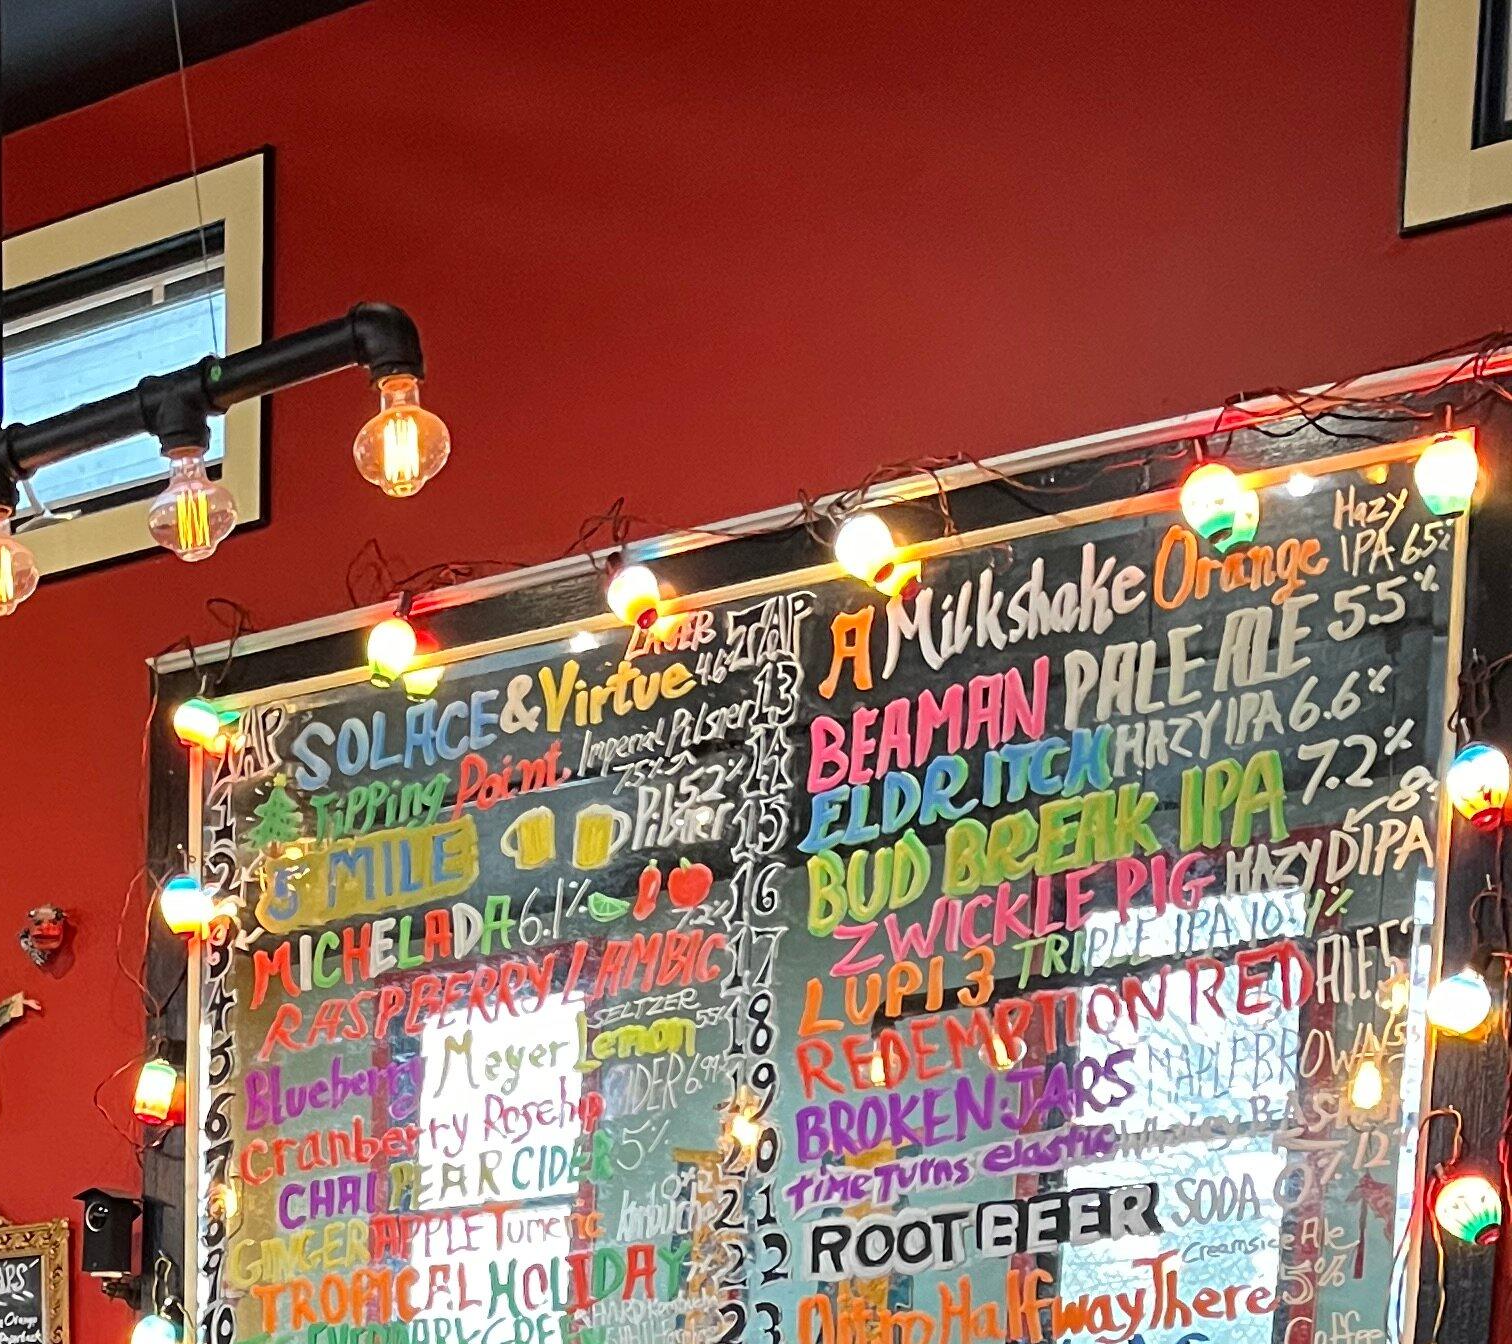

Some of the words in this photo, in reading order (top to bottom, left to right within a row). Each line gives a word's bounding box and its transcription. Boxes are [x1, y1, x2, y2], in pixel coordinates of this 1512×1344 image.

[1334, 484, 1408, 536] Hazy
[1341, 525, 1396, 578] IPA
[819, 605, 876, 700] A
[882, 542, 1147, 680] Milkshake
[1153, 524, 1330, 612] Orange
[807, 655, 1050, 794] BEAMAN
[1064, 623, 1207, 732] PALE
[1224, 689, 1285, 746] IPA
[1289, 665, 1392, 733] 6.6%
[310, 772, 453, 843] Tipping
[806, 827, 931, 938] BUD
[941, 783, 1162, 898] BREAK
[1180, 750, 1290, 852] IPA
[1298, 718, 1416, 806] 7.2%
[327, 829, 465, 908] MILE
[829, 862, 1104, 978] ZWICKLE
[1115, 852, 1217, 931] PIG
[249, 894, 517, 1010] MICHELADA
[518, 876, 593, 947] 6.1%
[256, 950, 557, 1062] RASPBERRY
[562, 928, 729, 1006] LAMBIC
[588, 987, 701, 1029] SELTZER
[795, 963, 1171, 1100] REDEMPTION
[1185, 937, 1315, 1025] RED
[798, 956, 945, 1037] LUPI
[956, 944, 995, 1008] 3
[244, 1055, 429, 1132] Blueberry
[433, 1029, 570, 1098] Meyer
[573, 1010, 697, 1073] Lemon
[240, 1115, 470, 1187] Cranberry
[795, 1075, 996, 1164] BROKEN
[277, 1170, 378, 1230] CHAI
[511, 1130, 615, 1191] CIDER
[615, 1118, 670, 1172] 5%
[713, 1182, 780, 1234] 21
[368, 1204, 484, 1259] APPLE
[714, 1233, 790, 1288] 22
[809, 1208, 974, 1275] ROOT
[978, 1182, 1162, 1257] BEER
[1171, 1173, 1262, 1228] SODA
[249, 1261, 484, 1334] TROPICAL
[487, 1241, 692, 1320] HOLIDAY
[1280, 1254, 1347, 1306] 5%
